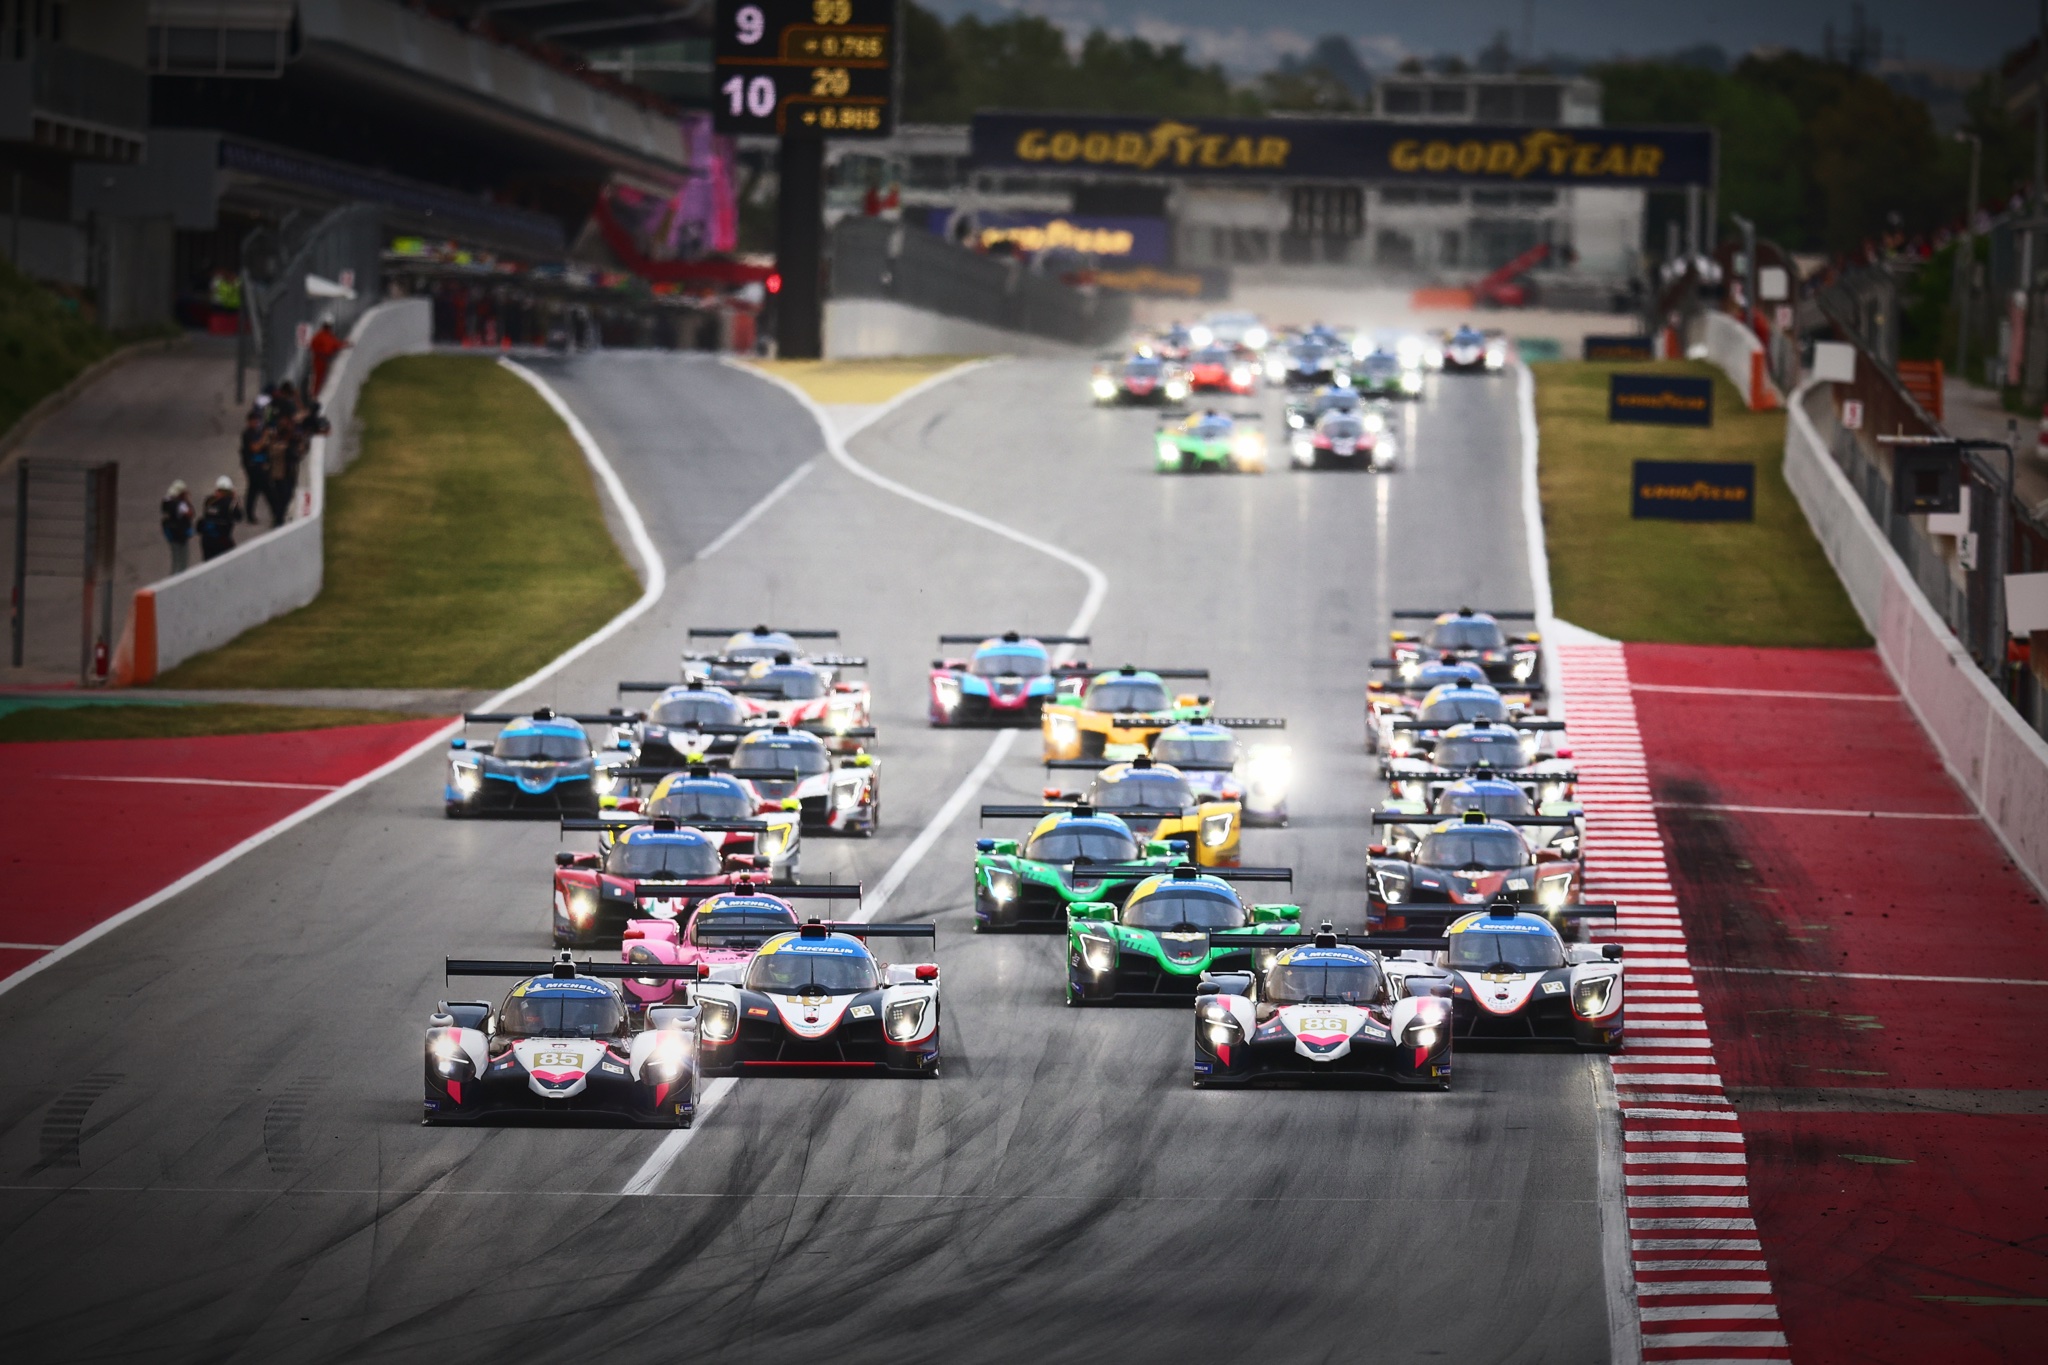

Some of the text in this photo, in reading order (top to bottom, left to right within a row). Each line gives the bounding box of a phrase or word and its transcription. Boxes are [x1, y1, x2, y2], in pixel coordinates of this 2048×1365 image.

[813, 0, 852, 25] 99
[735, 4, 765, 45] 9
[722, 75, 776, 118] 10
[1016, 120, 1291, 170] GOODYEAR
[1388, 130, 1664, 179] GOODYEAR
[729, 899, 783, 912] MICHELIN
[1482, 923, 1541, 933] MICHELIN
[795, 945, 854, 954] MICHELIN
[1309, 952, 1368, 965] MICHELIN
[546, 981, 607, 996] MICHELIN
[1544, 982, 1563, 992] P3
[852, 1006, 872, 1017] P3
[1304, 1019, 1343, 1031] 86
[539, 1052, 579, 1066] 85
